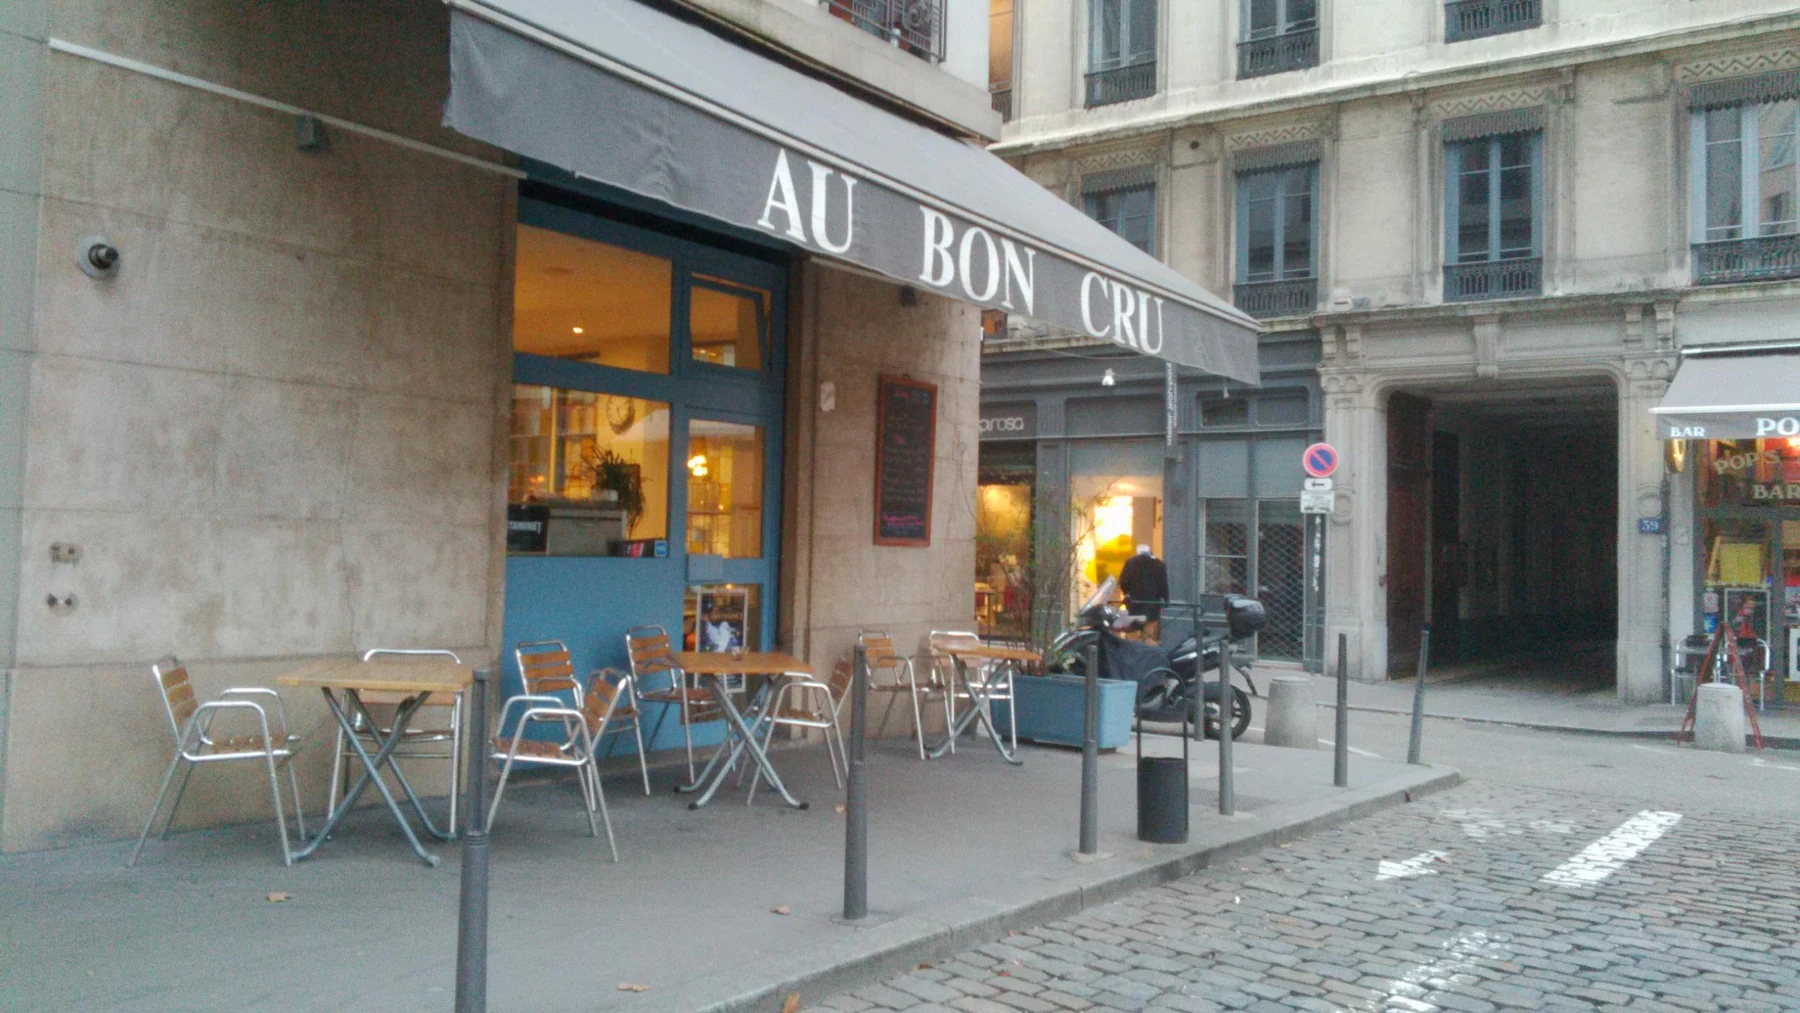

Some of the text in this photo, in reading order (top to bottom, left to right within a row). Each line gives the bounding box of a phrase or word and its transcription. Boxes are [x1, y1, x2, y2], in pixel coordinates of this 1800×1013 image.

[757, 148, 1164, 355] AU BON CRU
[1670, 427, 1706, 437] BAR
